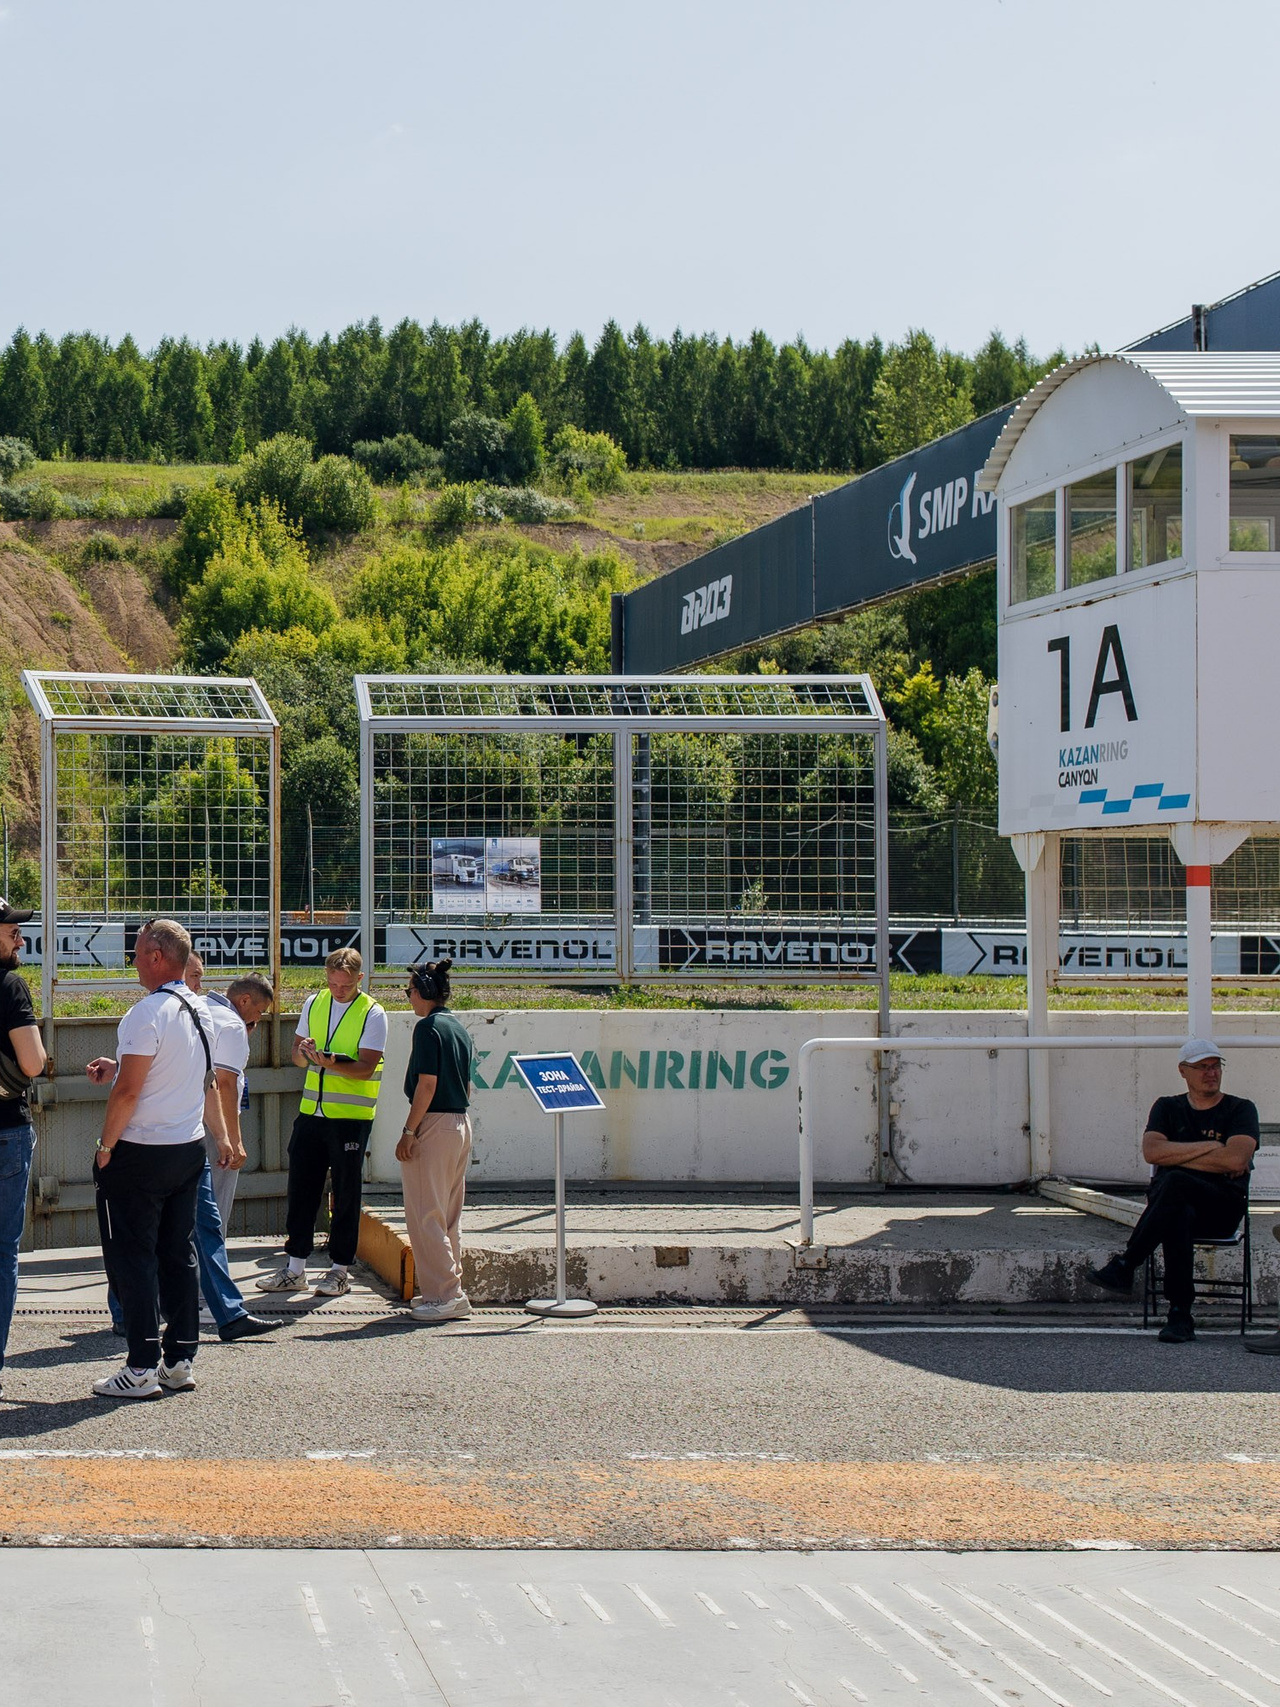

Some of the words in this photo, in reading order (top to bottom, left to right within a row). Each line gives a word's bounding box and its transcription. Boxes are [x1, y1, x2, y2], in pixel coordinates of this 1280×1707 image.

[919, 477, 968, 539] SMP
[1047, 624, 1138, 732] 1A
[1059, 740, 1129, 768] KAZANRING
[1058, 769, 1099, 788] CANYON
[433, 939, 612, 960] RAVENOL
[993, 945, 1188, 968] RVENOL
[470, 1050, 790, 1090] KAANRING
[538, 1070, 570, 1082] ЗОНА
[536, 1082, 587, 1094] ТЕСТ-ДРАЙВА
